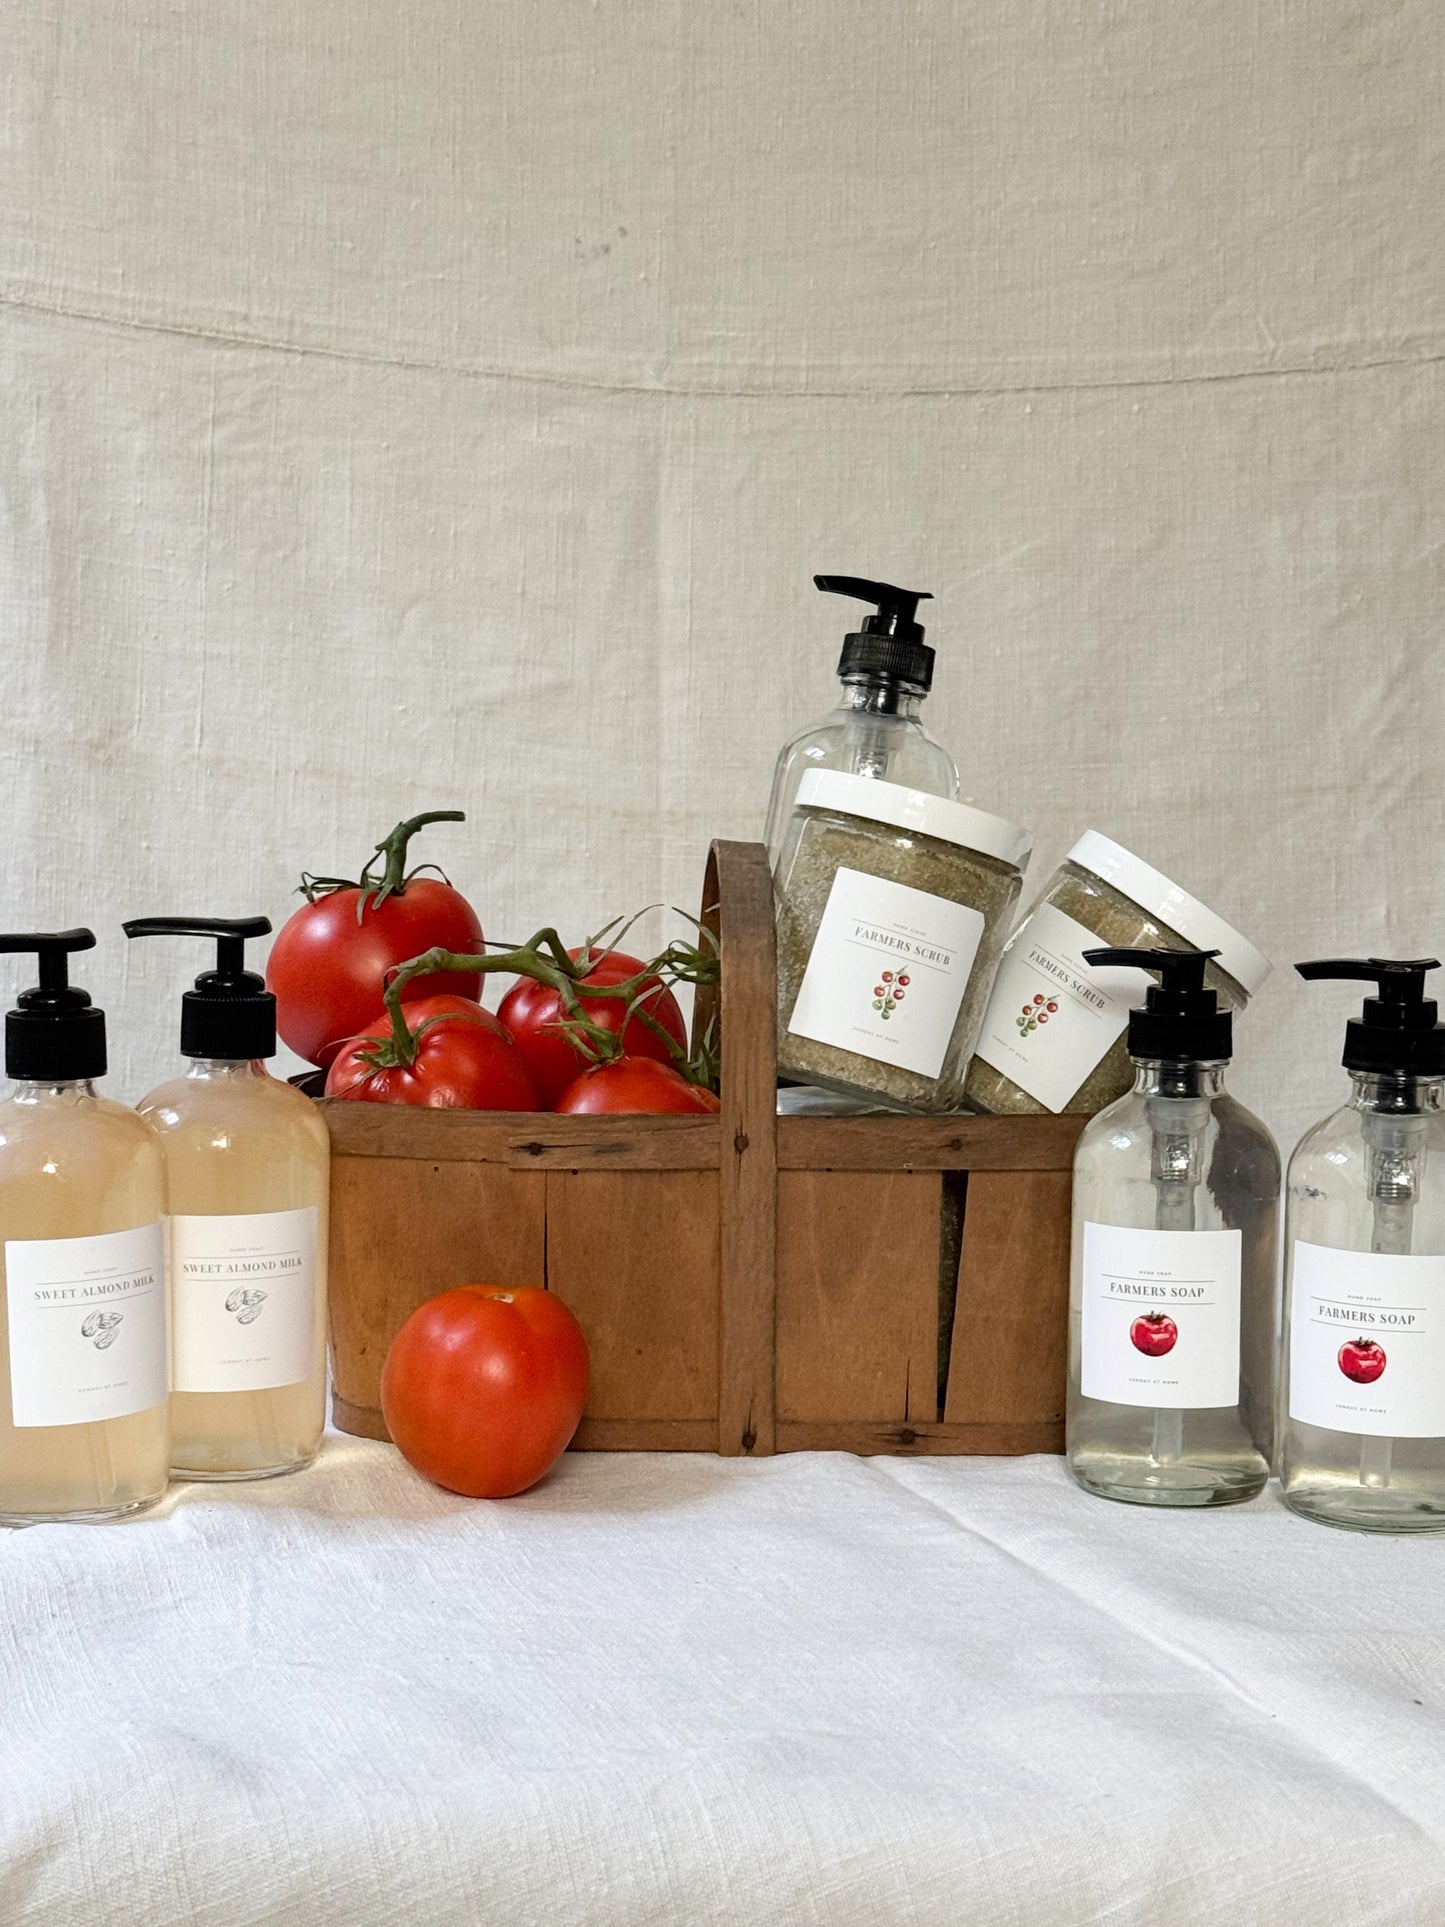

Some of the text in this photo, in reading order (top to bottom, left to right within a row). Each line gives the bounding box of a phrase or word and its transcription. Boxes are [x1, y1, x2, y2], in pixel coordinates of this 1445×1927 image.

[854, 926, 912, 952] FARMERS
[913, 945, 951, 966] SCRUB
[1028, 950, 1071, 983] FARMERS
[1070, 979, 1106, 1009] SCRUB
[183, 1257, 303, 1274] SWEET ALMOND MILK
[33, 1274, 155, 1301] SWEET ALMOND MILK
[1110, 1282, 1205, 1298] FARMERS SOAP
[1318, 1305, 1416, 1325] FARMERS SOAP
